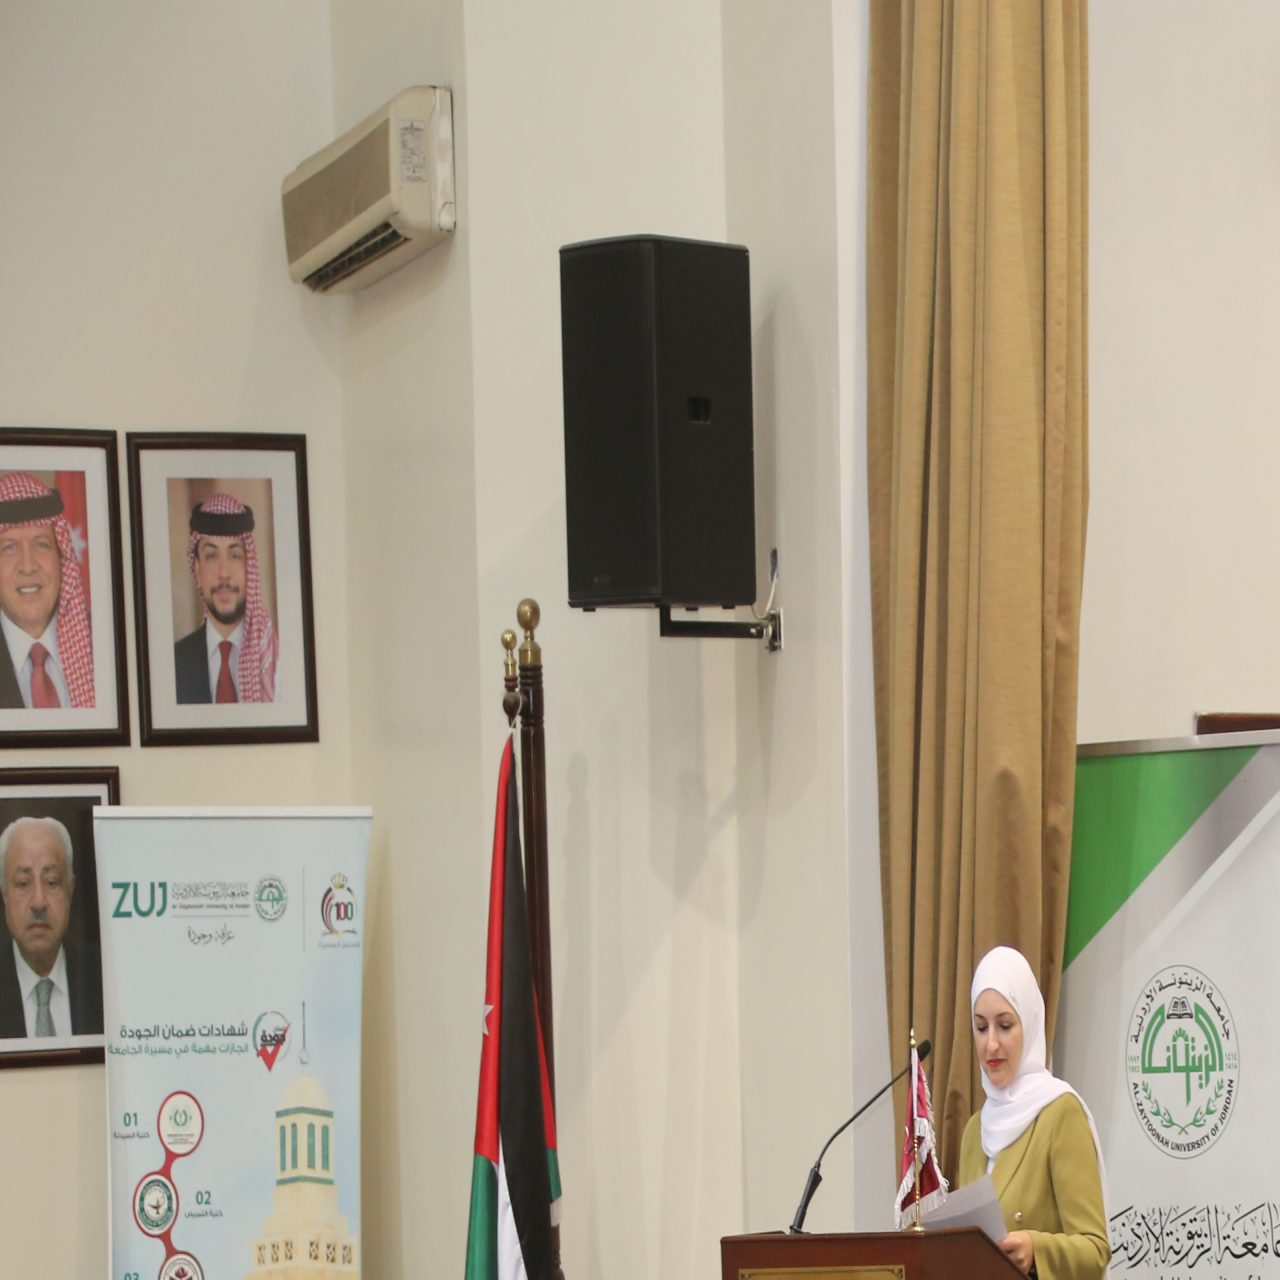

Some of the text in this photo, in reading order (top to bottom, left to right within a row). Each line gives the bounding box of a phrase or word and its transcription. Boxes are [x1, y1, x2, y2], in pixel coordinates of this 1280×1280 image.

[111, 881, 168, 918] ZUJ
[334, 901, 354, 921] 100
[1156, 972, 1207, 994] الزيتونة
[1206, 985, 1230, 1041] جامعة
[119, 1021, 249, 1041] شهادات ضمان الجودة
[123, 1111, 138, 1127] 01
[1132, 1079, 1234, 1152] AL-ZAYTOONAH UNIVERSITY OF JORDAN
[195, 1190, 212, 1205] 02
